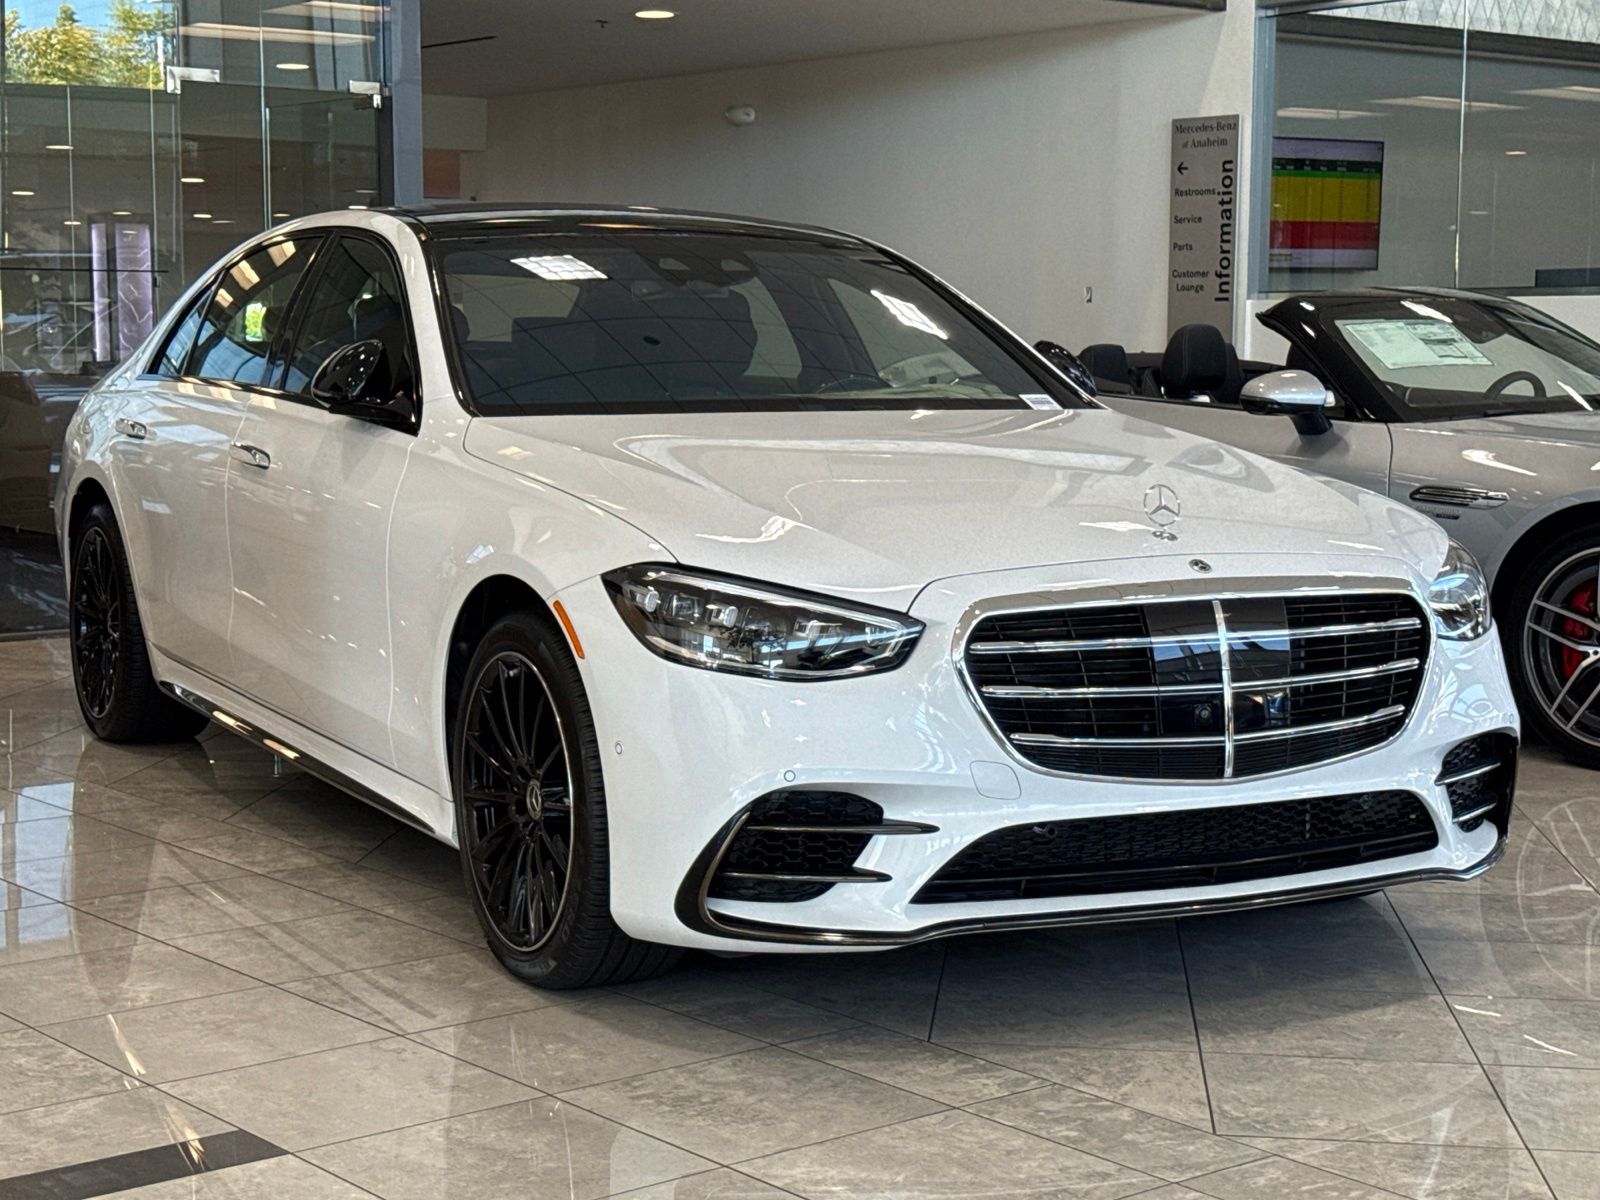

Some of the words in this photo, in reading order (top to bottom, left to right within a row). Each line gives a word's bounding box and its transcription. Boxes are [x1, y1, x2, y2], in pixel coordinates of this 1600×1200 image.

[1175, 121, 1237, 134] Mercedes-Benz
[1191, 136, 1228, 148] Anaheim
[1174, 187, 1216, 198] Restrooms
[1174, 214, 1203, 224] Service
[1214, 159, 1234, 302] Information
[1173, 242, 1193, 251] Parts
[1172, 269, 1210, 279] Customer
[1176, 283, 1204, 294] Lounge
